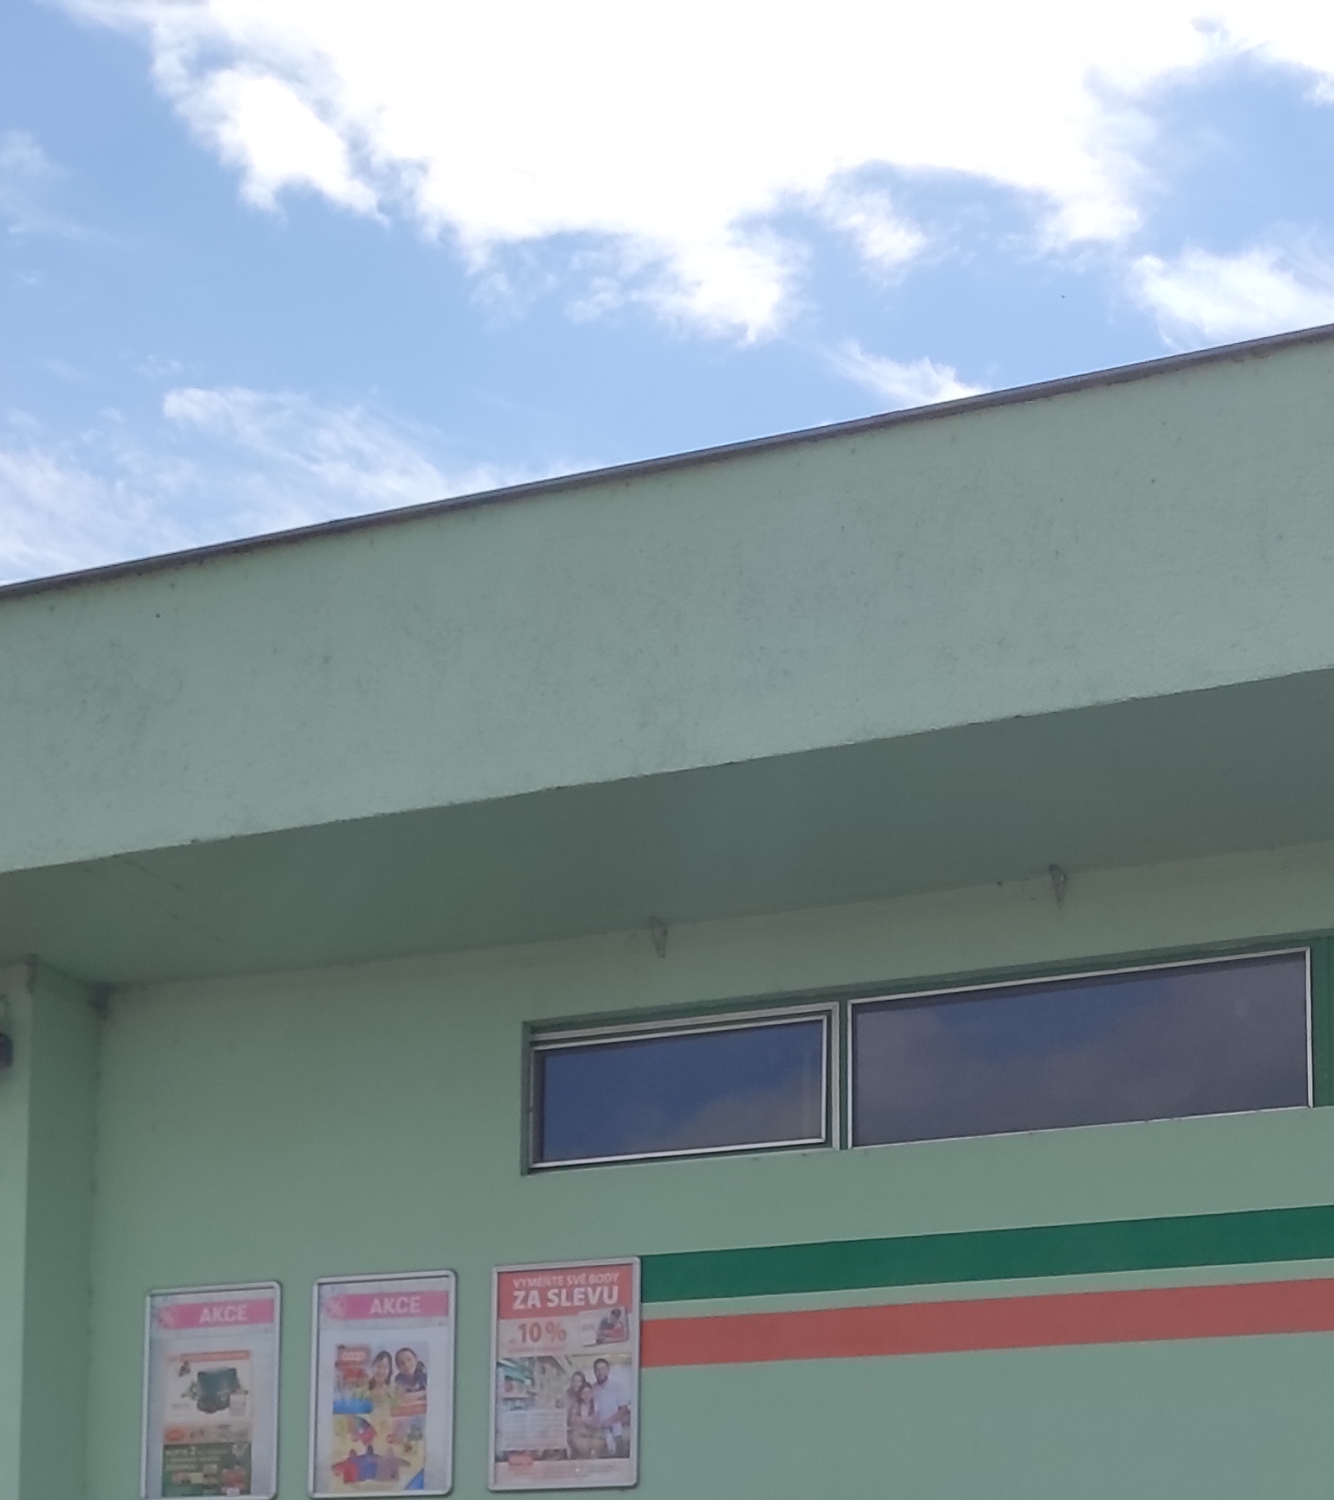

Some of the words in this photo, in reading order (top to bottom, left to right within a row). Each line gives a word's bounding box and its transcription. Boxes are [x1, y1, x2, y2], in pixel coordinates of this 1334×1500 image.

[588, 1272, 620, 1285] BODY
[369, 1296, 421, 1316] AKCE
[513, 1290, 542, 1309] ZA
[546, 1285, 619, 1307] SLEVU
[199, 1304, 249, 1324] AKCE
